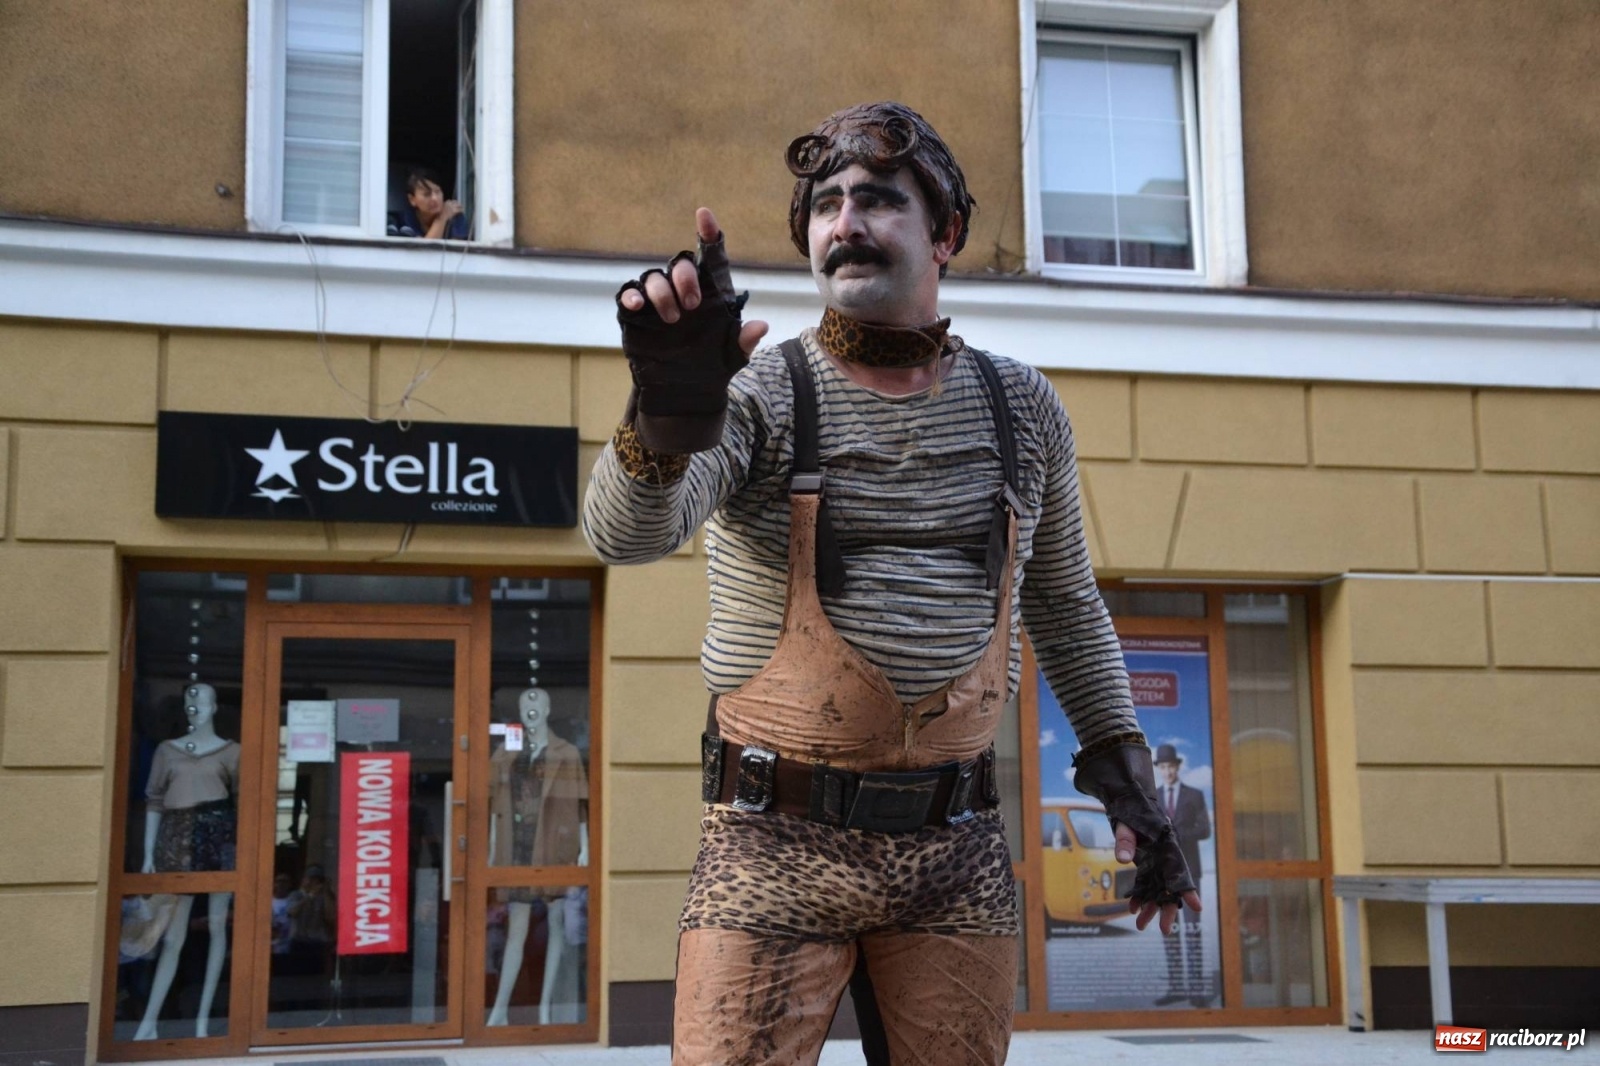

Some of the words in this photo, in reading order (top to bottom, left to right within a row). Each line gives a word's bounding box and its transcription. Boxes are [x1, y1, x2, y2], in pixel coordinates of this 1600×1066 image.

[317, 437, 499, 496] Stella
[431, 499, 498, 512] collezione
[1129, 677, 1171, 689] ZYGODA
[1131, 690, 1165, 702] SZTEM
[358, 759, 393, 825] NOWA
[354, 829, 392, 948] KOLEKCJA
